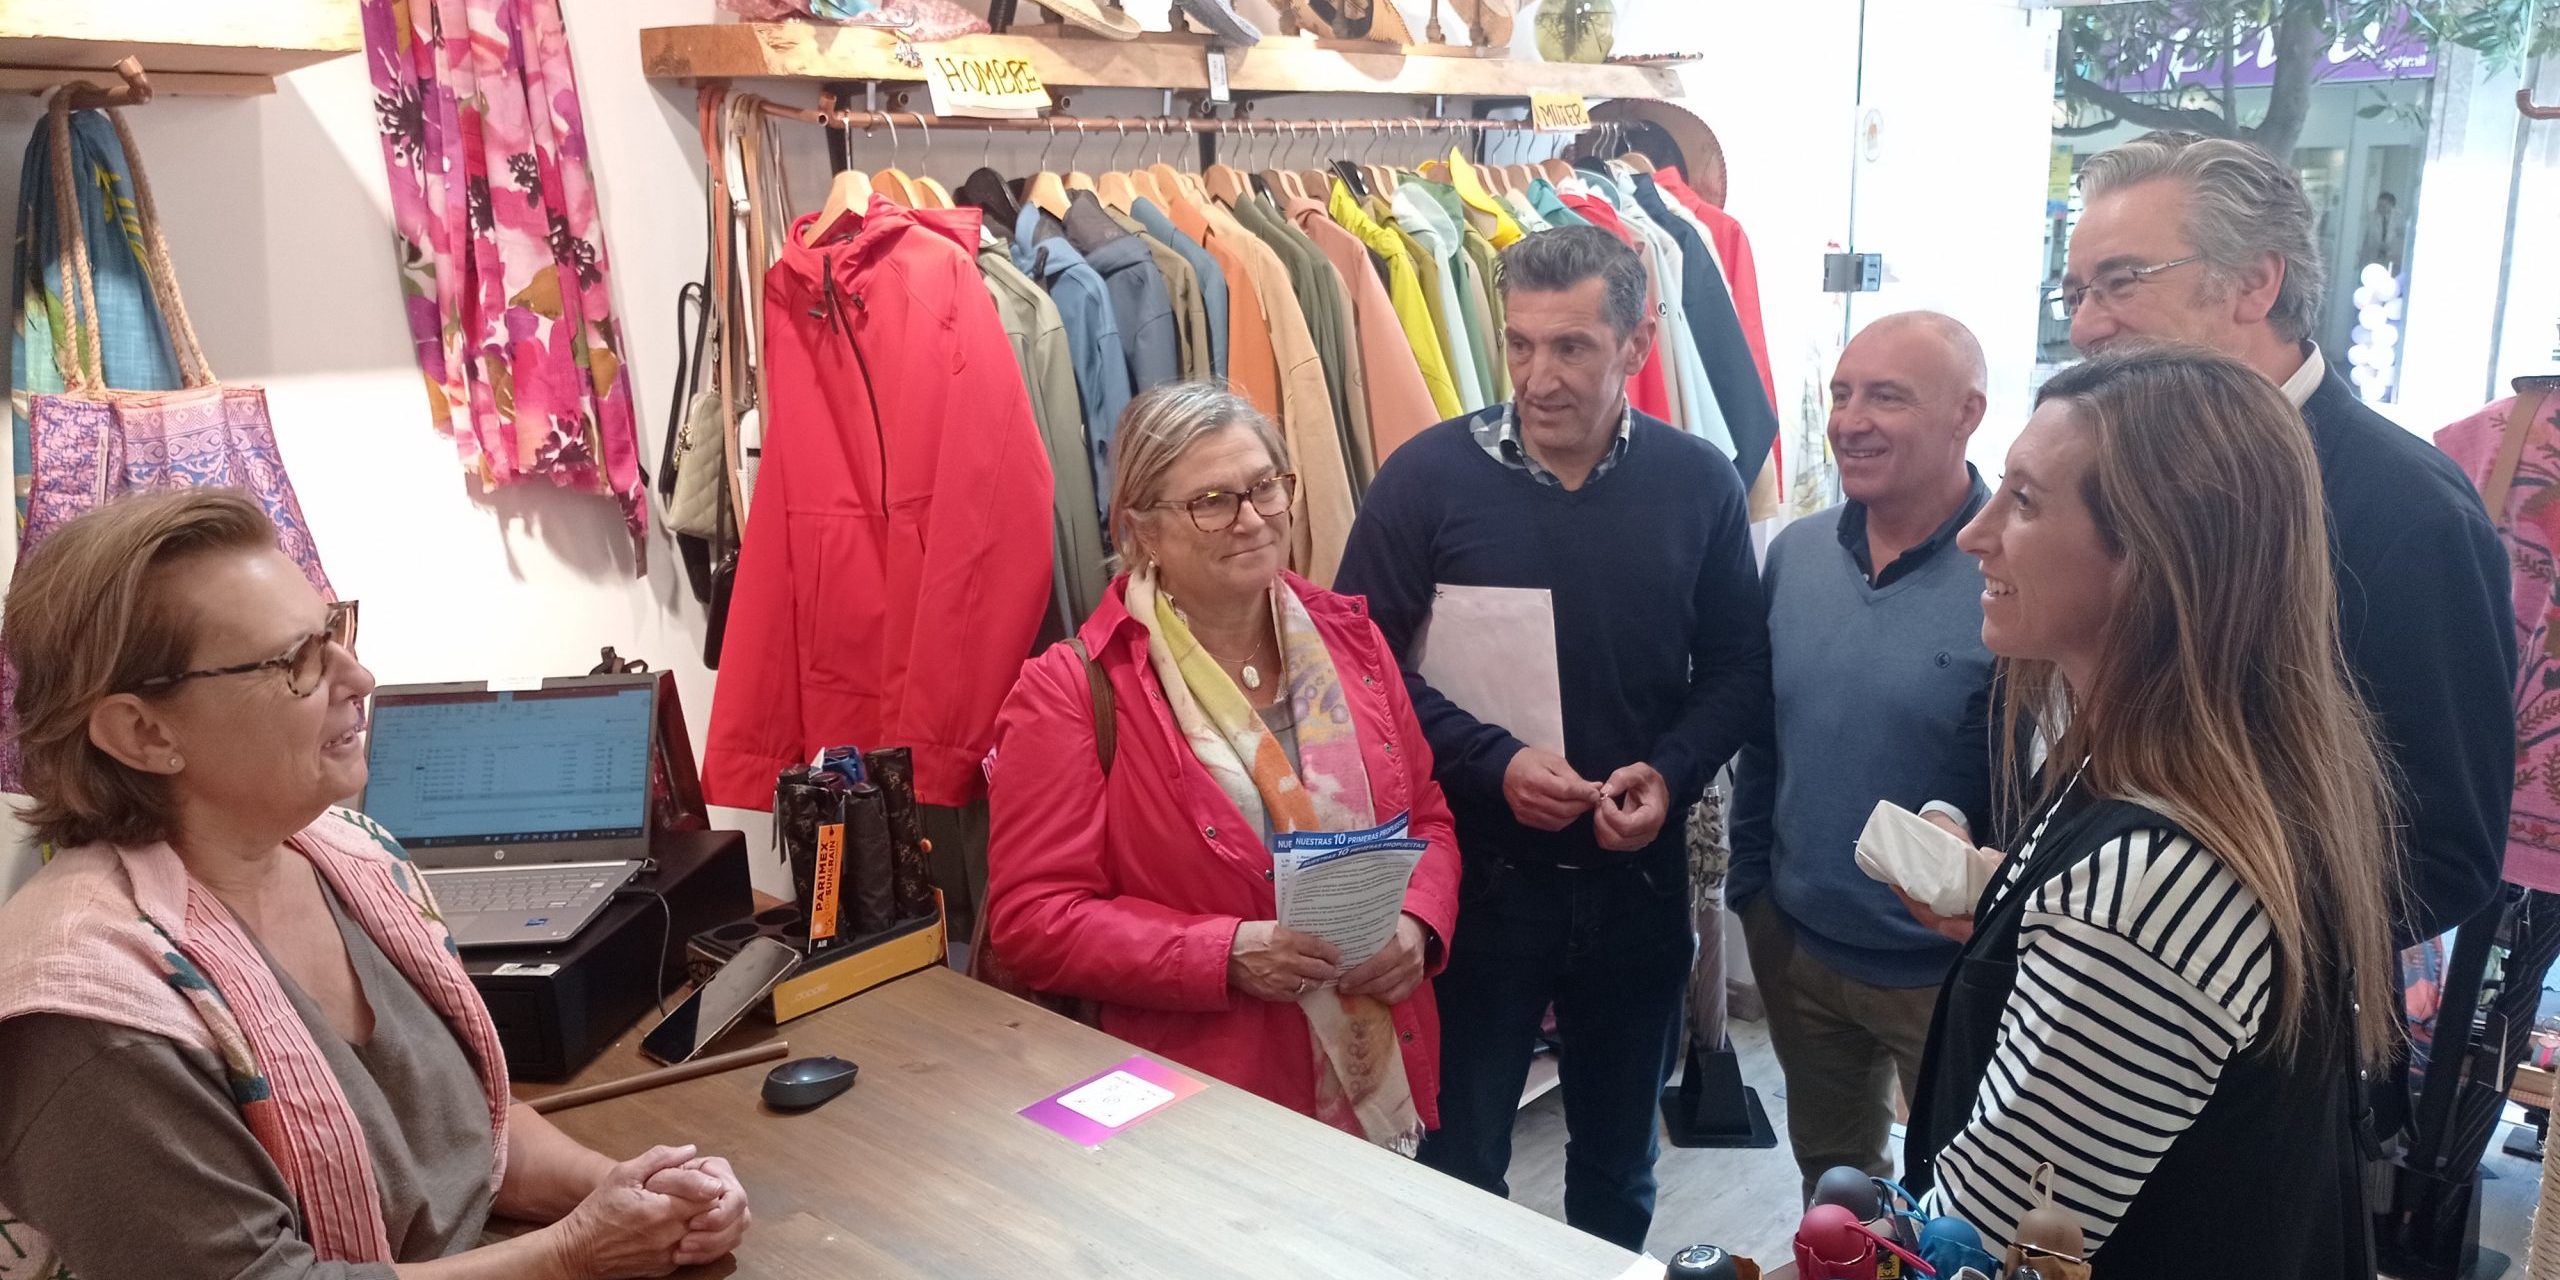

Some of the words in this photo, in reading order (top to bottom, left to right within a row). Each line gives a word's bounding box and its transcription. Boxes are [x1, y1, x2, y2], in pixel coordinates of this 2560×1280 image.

[935, 57, 1041, 96] HOMBRE
[1295, 836, 1333, 847] NUESTRAS
[1333, 833, 1347, 846] 10
[1347, 832, 1379, 845] PRIMERAS
[1337, 847, 1350, 857] 10
[815, 842, 829, 912] PARIMEX
[817, 939, 828, 948] AIR
